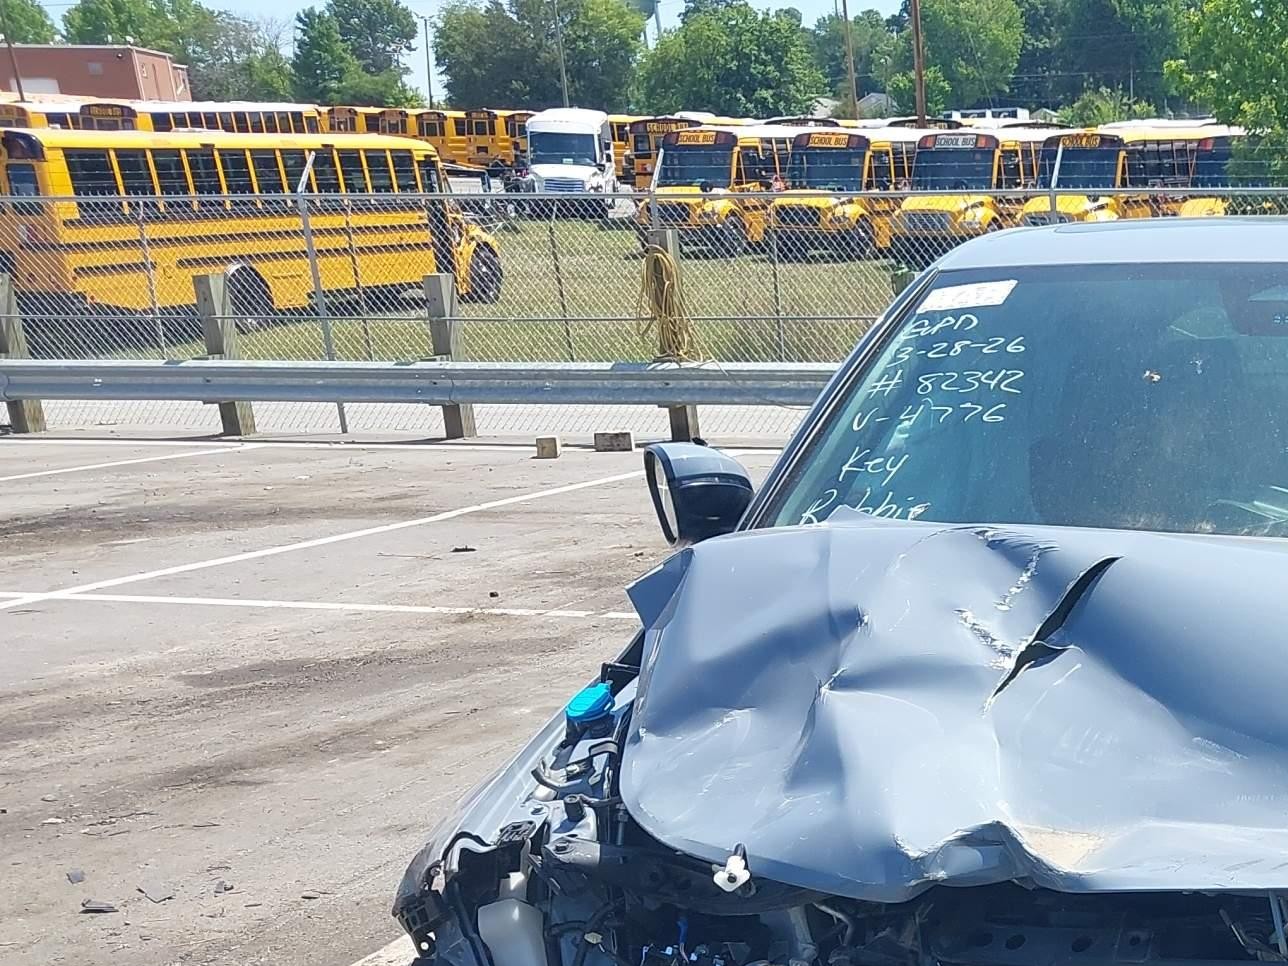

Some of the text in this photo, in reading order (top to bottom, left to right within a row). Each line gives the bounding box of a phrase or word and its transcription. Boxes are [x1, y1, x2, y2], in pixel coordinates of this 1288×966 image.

[680, 134, 714, 143] SCHOOL BUS
[810, 135, 847, 145] SCHOOL BUS
[936, 136, 975, 147] SCHOOL BUS
[1062, 137, 1099, 147] SCHOOL BUS
[887, 336, 1026, 368] 3-28-26
[871, 369, 1025, 397] # 82342
[839, 446, 909, 487] Key
